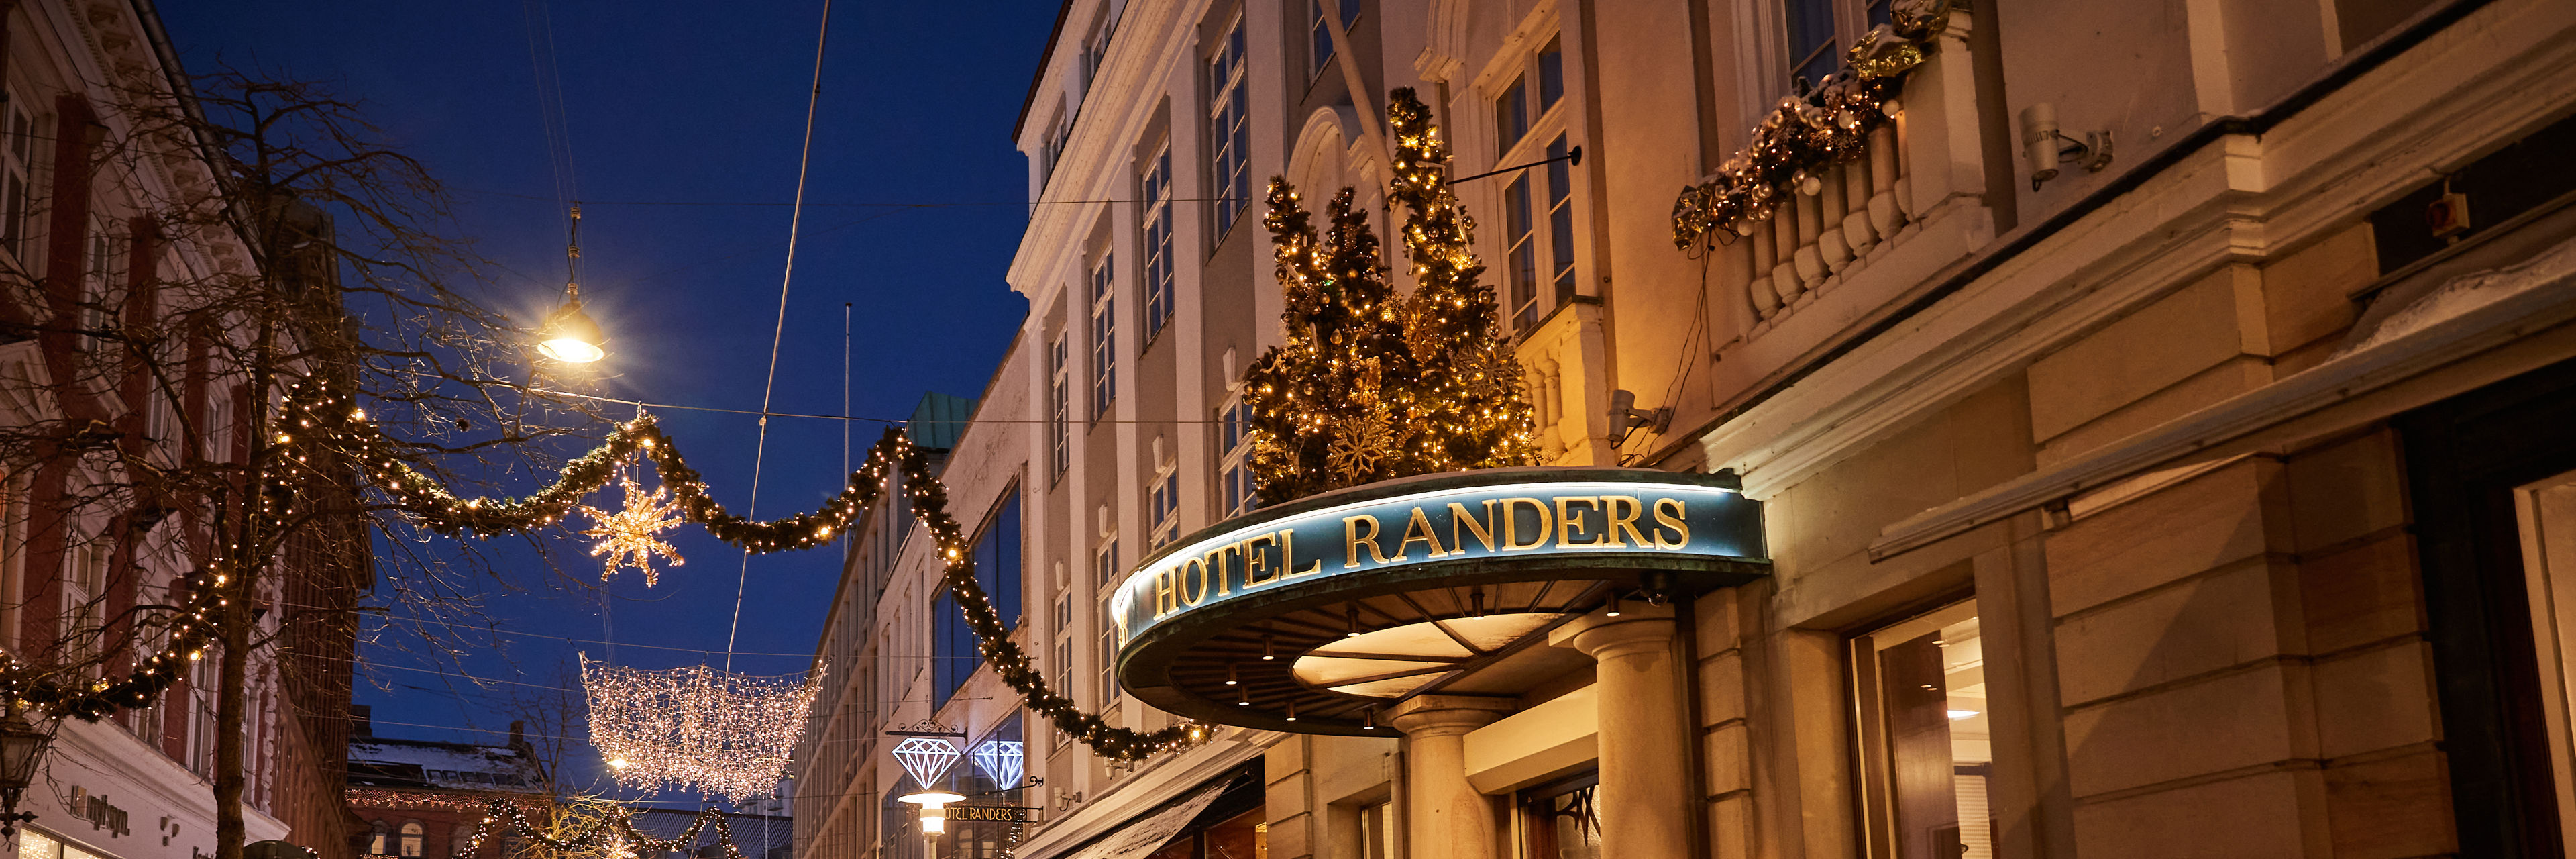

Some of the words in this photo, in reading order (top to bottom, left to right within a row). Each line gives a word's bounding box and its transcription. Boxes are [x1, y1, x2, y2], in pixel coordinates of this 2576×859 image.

[1153, 528, 1321, 621] HOTEL
[1343, 495, 1690, 568] RANDERS
[944, 807, 967, 820] OTEL
[970, 807, 1012, 821] RANDERS
